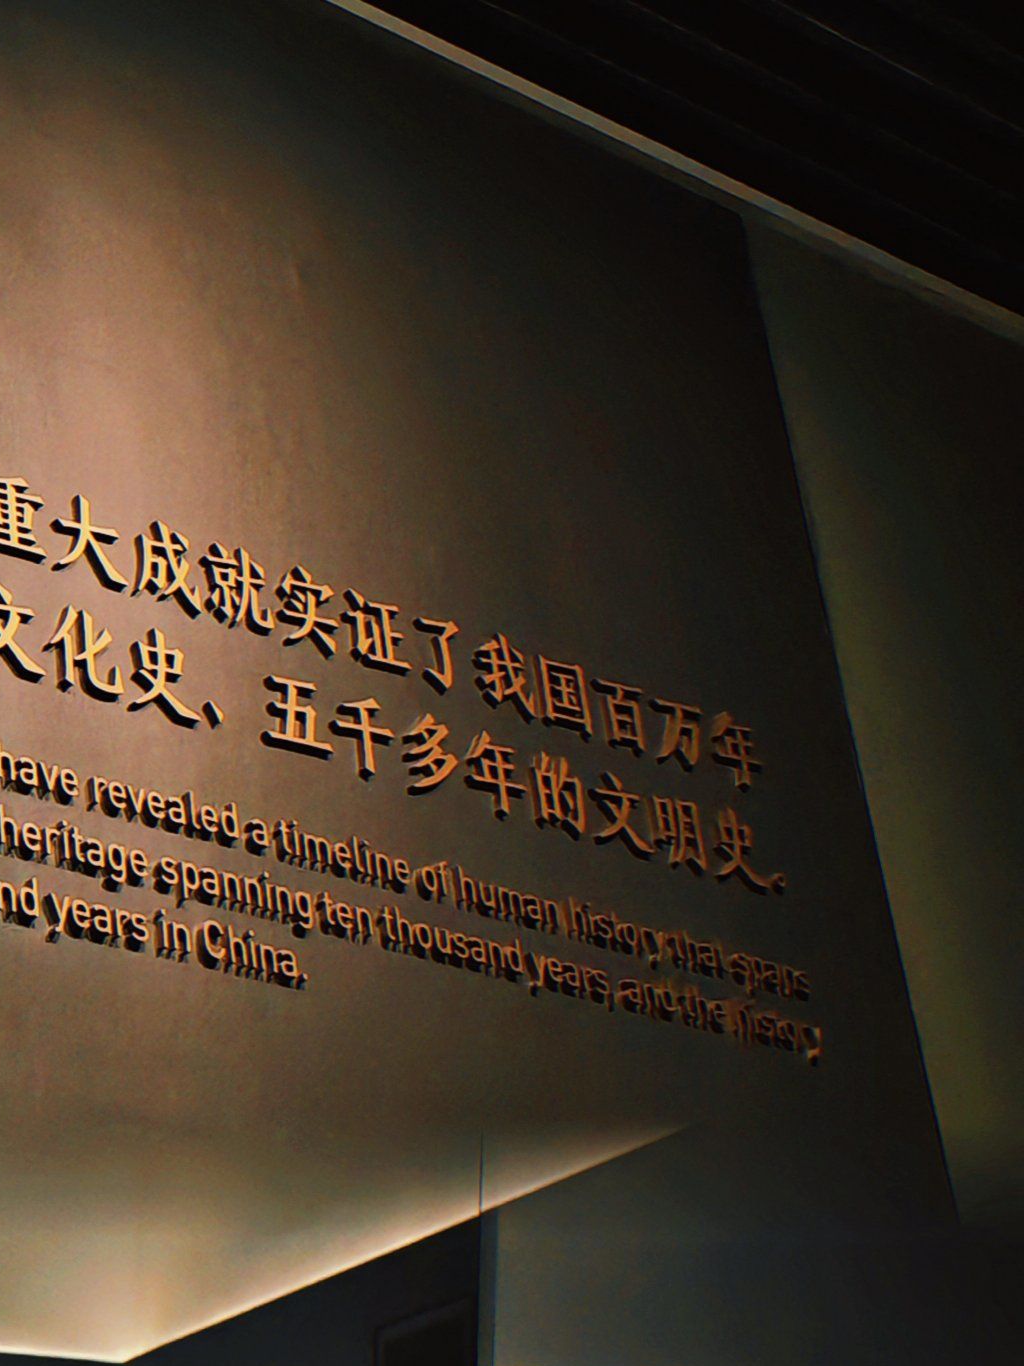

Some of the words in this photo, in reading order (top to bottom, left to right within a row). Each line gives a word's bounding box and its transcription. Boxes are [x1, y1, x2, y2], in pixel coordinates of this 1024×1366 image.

[87, 776, 240, 846] revealed
[244, 818, 271, 853] a
[274, 820, 410, 888] timeline
[414, 861, 449, 900] of
[452, 864, 559, 930] human
[563, 897, 667, 968] history
[154, 855, 315, 936] spanning
[316, 891, 374, 944] ten
[377, 905, 524, 982] thousand
[43, 891, 150, 947] years
[154, 908, 191, 962] in
[196, 919, 309, 988] China.
